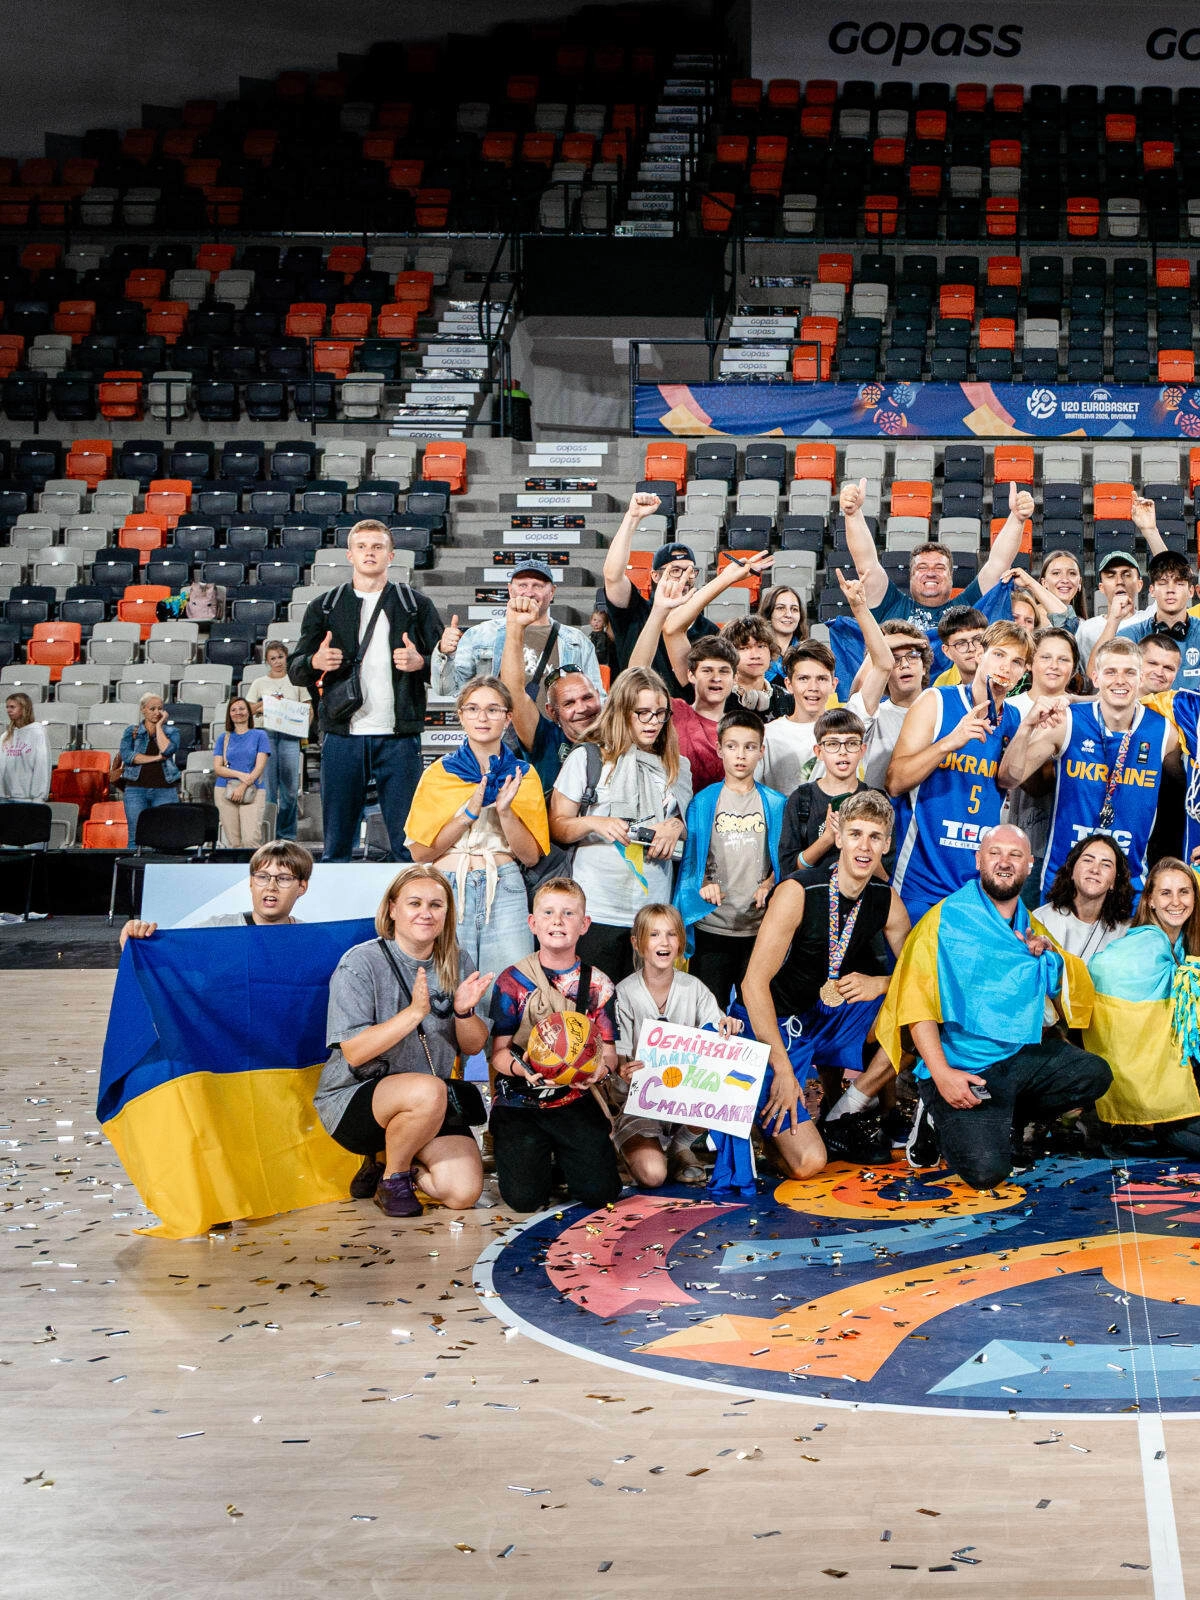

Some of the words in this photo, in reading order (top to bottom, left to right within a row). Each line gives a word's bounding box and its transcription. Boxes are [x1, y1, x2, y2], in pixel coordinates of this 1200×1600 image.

[1061, 402, 1081, 412] U20
[1081, 402, 1140, 413] EUROBASKET
[967, 785, 982, 815] 5
